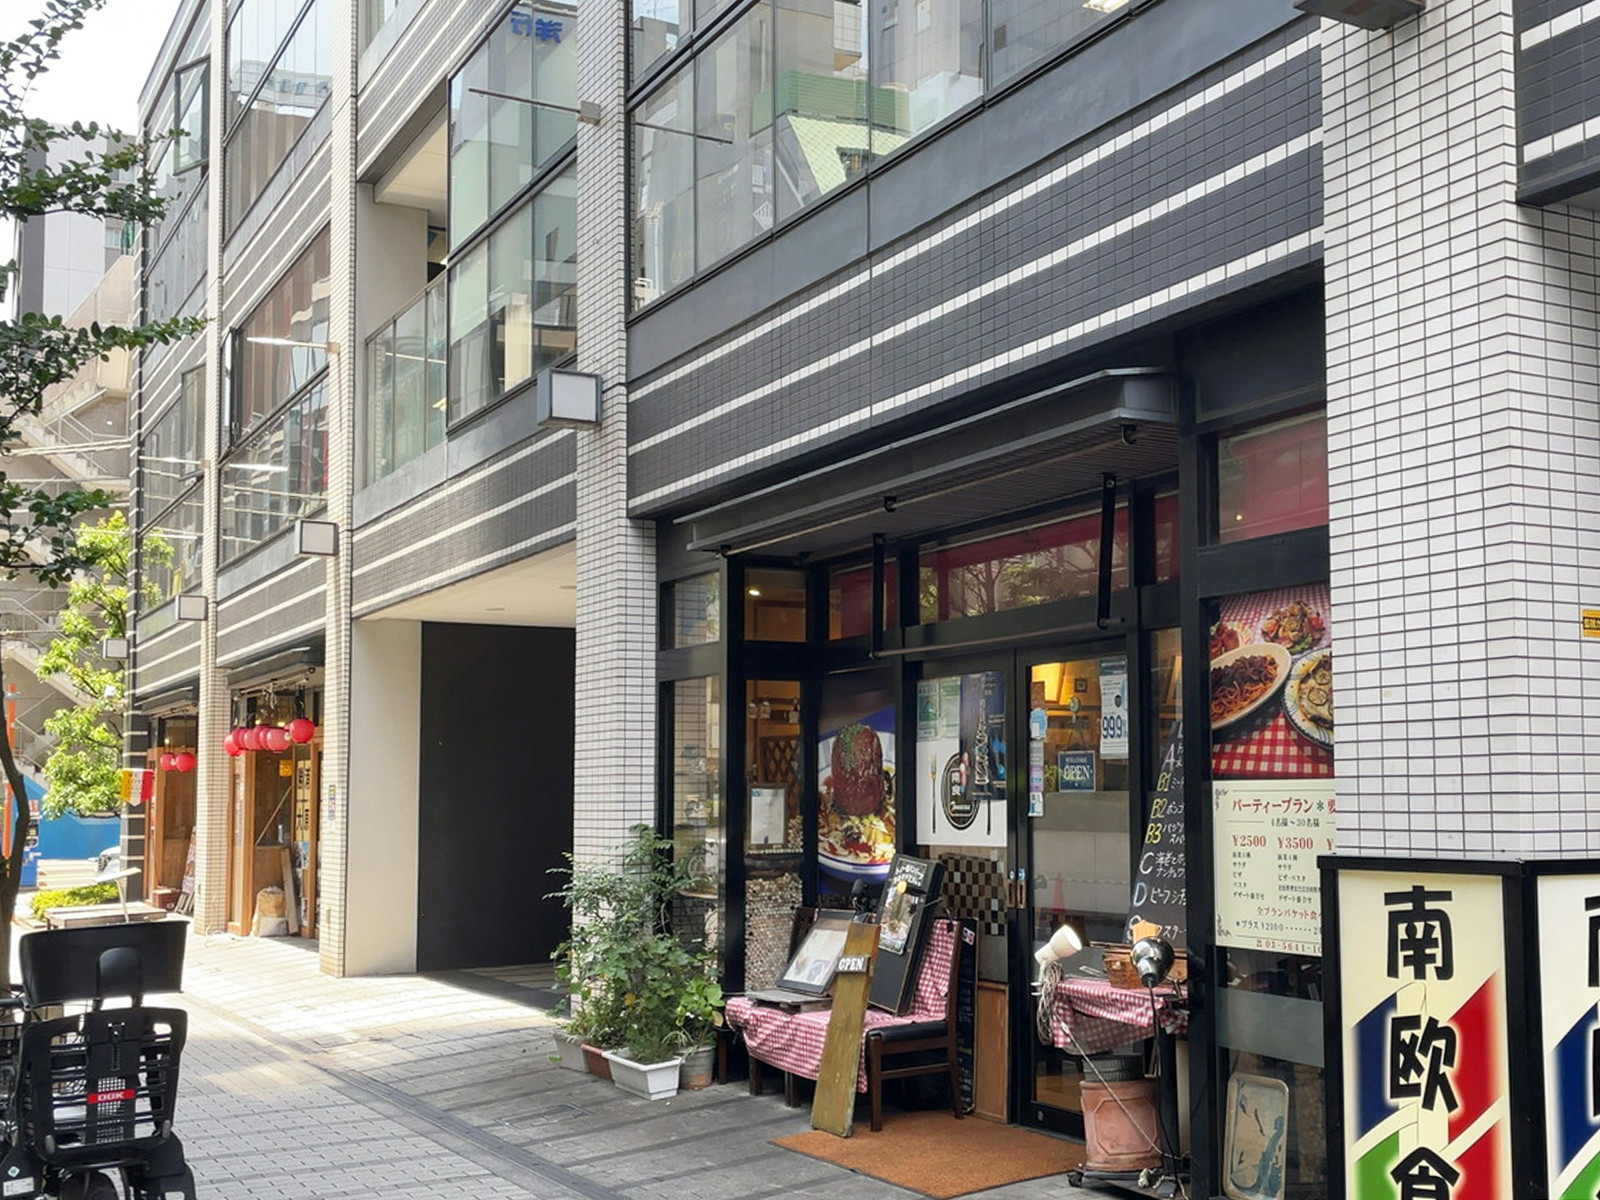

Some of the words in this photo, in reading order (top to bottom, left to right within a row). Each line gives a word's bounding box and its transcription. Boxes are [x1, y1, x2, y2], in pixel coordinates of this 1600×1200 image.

[1063, 764, 1090, 780] OPEN
[1157, 771, 1171, 791] B1
[1151, 798, 1168, 818] B2
[1145, 823, 1162, 844] B3
[1232, 835, 1266, 847] ¥2500
[1278, 837, 1314, 849] ¥3500
[1140, 852, 1155, 874] C
[1133, 882, 1147, 907] D
[838, 957, 865, 971] OPEN
